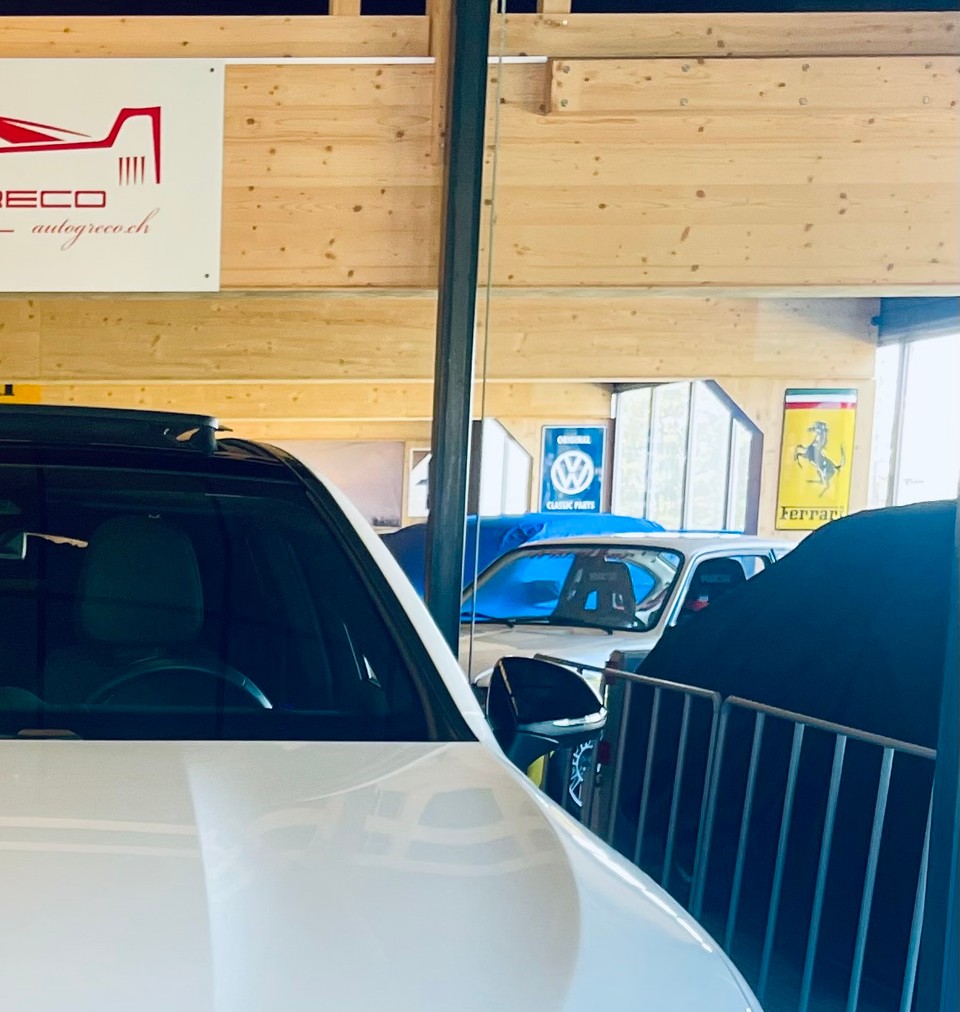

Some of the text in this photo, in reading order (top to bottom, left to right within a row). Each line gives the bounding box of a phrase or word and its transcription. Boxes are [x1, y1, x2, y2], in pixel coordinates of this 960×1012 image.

[32, 207, 160, 251] autogreco.ch
[546, 501, 595, 510] CLASSIC PARTS
